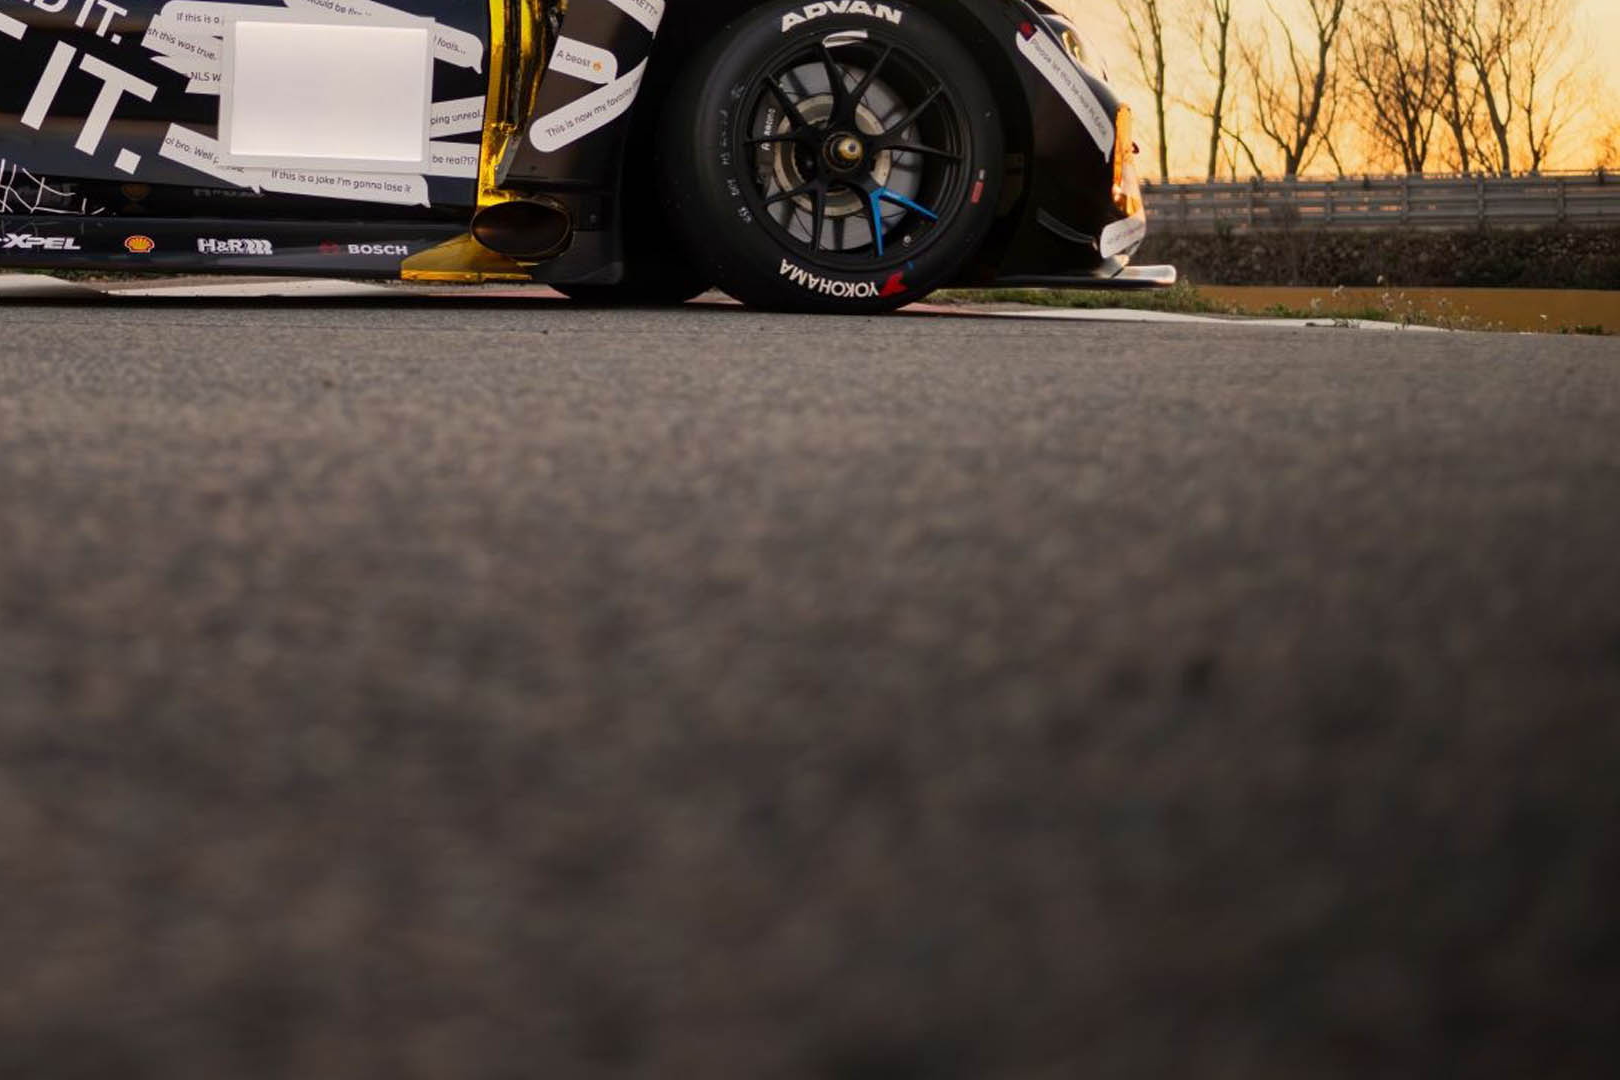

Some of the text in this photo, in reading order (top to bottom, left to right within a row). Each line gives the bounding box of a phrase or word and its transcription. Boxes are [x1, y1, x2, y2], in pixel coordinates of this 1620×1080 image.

[334, 4, 347, 14] be
[781, 0, 903, 33] ADVAN
[185, 13, 202, 23] this
[203, 14, 212, 24] is
[159, 31, 176, 44] this
[177, 40, 196, 53] was
[196, 45, 218, 60] true.
[556, 49, 591, 67] A beast
[20, 44, 158, 175] IT.
[430, 115, 450, 125] oing
[545, 123, 566, 138] This
[566, 119, 575, 129] is
[575, 111, 593, 125] now
[593, 104, 607, 114] my
[194, 146, 213, 160] Well
[432, 154, 444, 163] be
[271, 169, 279, 179] If
[279, 170, 296, 181] this
[298, 172, 306, 182] is
[315, 174, 335, 185] joke
[337, 176, 352, 186] I'm
[353, 179, 382, 190] gonna
[384, 182, 403, 193] lose
[404, 184, 412, 193] it
[0, 233, 81, 250] XPEL
[197, 238, 246, 255] H&R
[347, 243, 409, 256] BOSCH
[779, 258, 879, 298] YOKOHAMA
